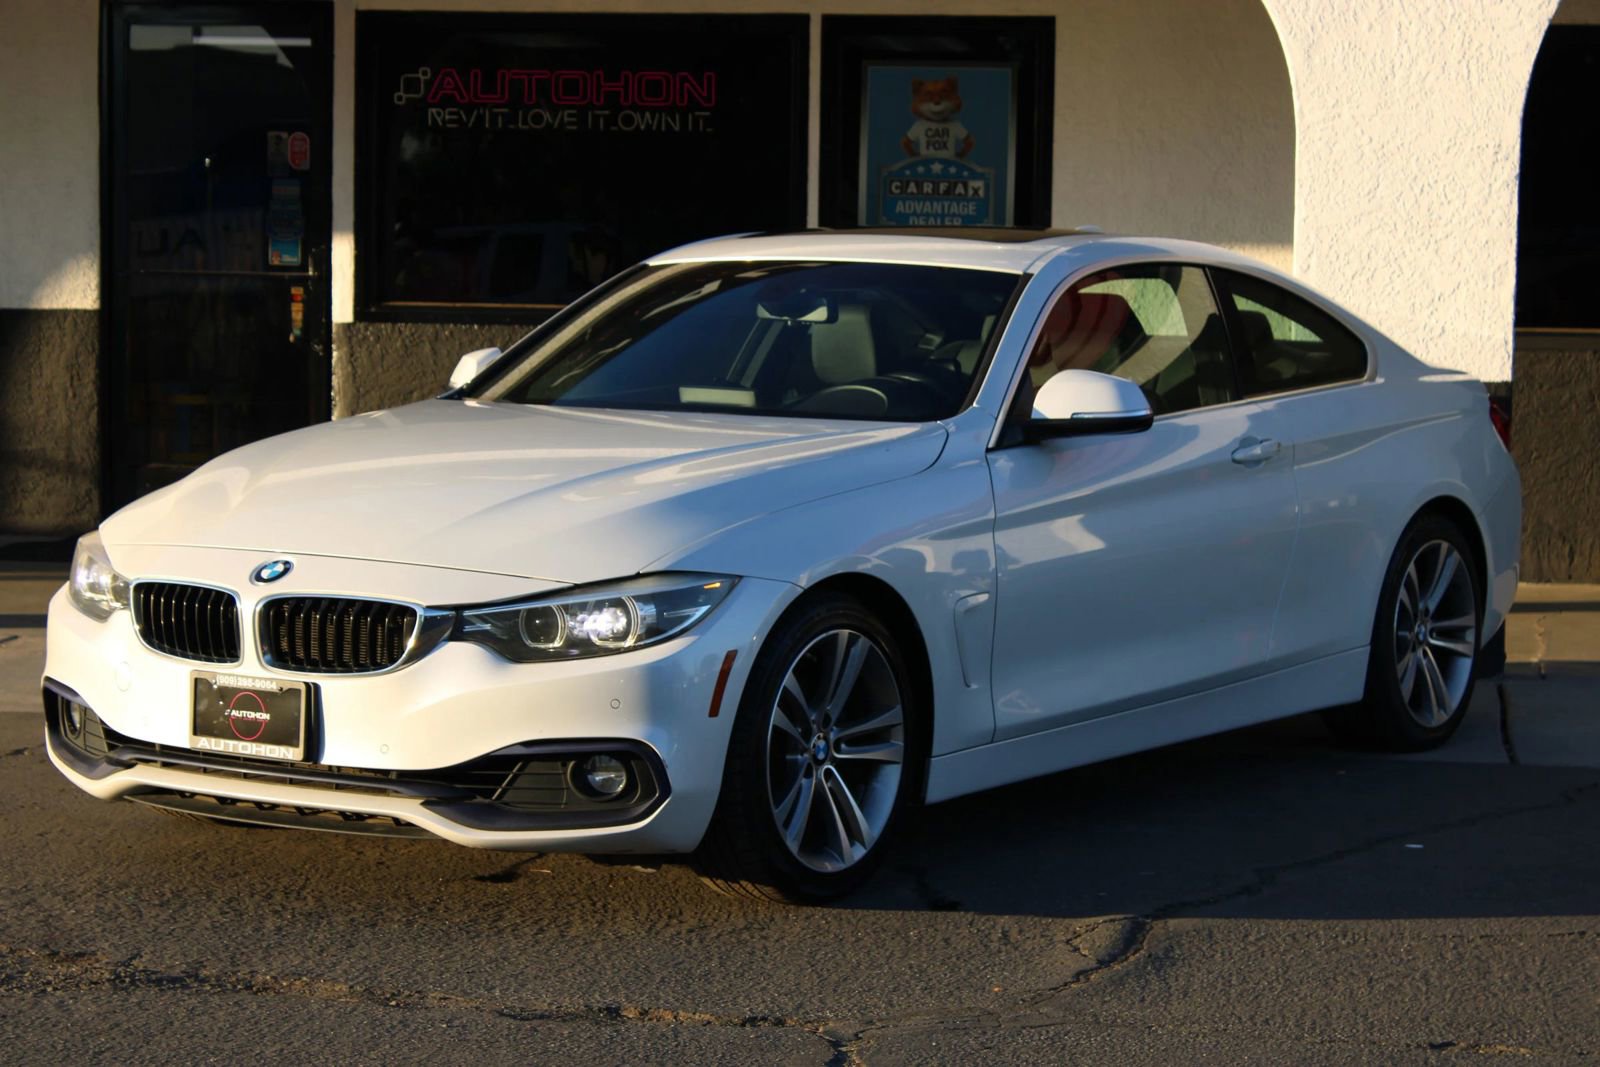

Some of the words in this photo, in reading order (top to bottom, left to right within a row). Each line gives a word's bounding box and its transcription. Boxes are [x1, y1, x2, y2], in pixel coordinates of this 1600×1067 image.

[426, 68, 717, 107] AUTOHON
[925, 128, 950, 139] CAR
[925, 140, 949, 151] FOX
[890, 180, 983, 197] CARFAX
[896, 200, 977, 215] ADVANTAGE
[231, 709, 270, 720] AUTOHON
[197, 738, 294, 760] AUTOHON
